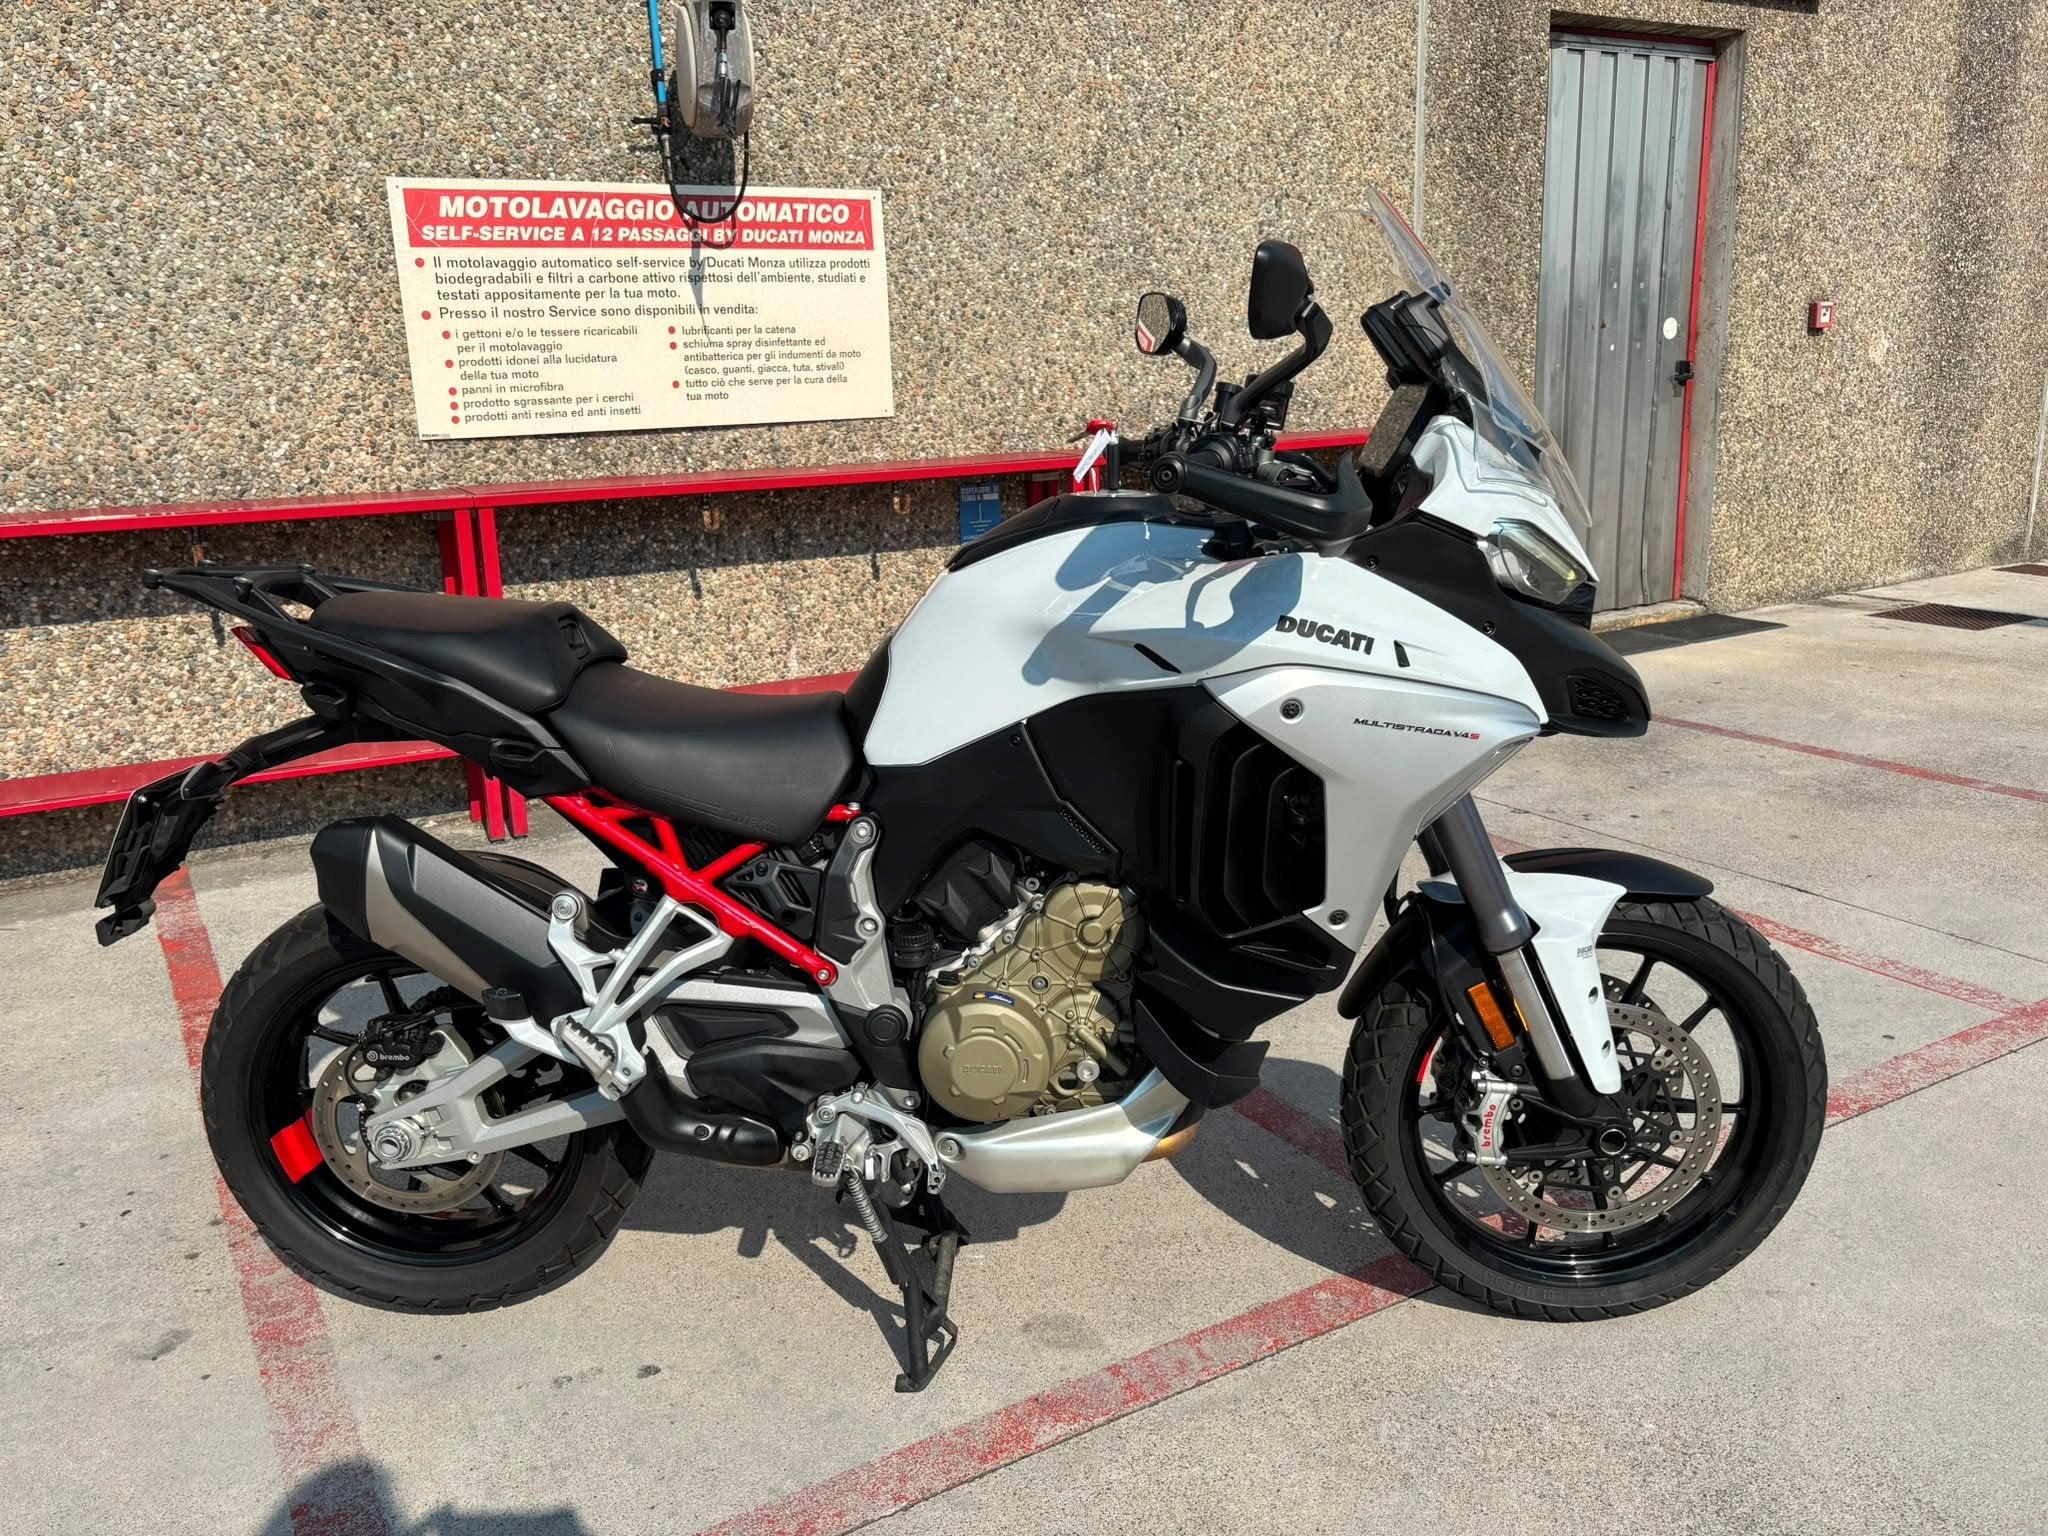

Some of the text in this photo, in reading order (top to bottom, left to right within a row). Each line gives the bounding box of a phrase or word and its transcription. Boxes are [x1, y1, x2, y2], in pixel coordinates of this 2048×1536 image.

[439, 195, 850, 225] MOTOLAVAGGIO AUTOMATICO
[421, 225, 865, 244] SELF-SERVICE A 12 PASSAGGI BY DUCATI MONZA
[433, 256, 870, 271] Il motolavaggio automatico self-service by Ducati Monza utilizza prodotti
[435, 272, 866, 287] biodegradabili e filtri a carbone attivo rispettosi dell'ambiente, studiati e
[437, 288, 680, 303] testati appositamente per la tua moto.
[439, 304, 758, 319] Presso il nostro Service sono disponibili in vendita:
[455, 326, 638, 341] i gettoni e/o le tessere ricaricabili
[682, 325, 796, 337] lubrificanti per la catena
[457, 341, 563, 355] per il motolavaggio
[683, 337, 826, 350] schiuma spray disinfettante ed
[458, 353, 617, 369] prodotti idonei alla lucidatura
[684, 350, 861, 362] antibatterica per gli indumenti da moto
[793, 363, 813, 373] tuta,
[815, 361, 845, 372] stivali)
[460, 370, 539, 381] della tua moto
[685, 374, 848, 388] tutto ciò che serve per la cura della
[461, 381, 564, 397] panni in microfibra
[686, 391, 729, 401] tua moto
[463, 398, 510, 411] prodotto
[514, 395, 572, 409] sgrassante
[576, 395, 593, 406] per
[602, 392, 634, 402] cerchi
[464, 405, 641, 424] prodotti anti resina ed anti insetti
[1275, 614, 1375, 655] DUCATI
[1353, 718, 1480, 740] MULTISTRADA V4S
[380, 1053, 410, 1062] brembo
[1480, 1104, 1496, 1147] brembo
